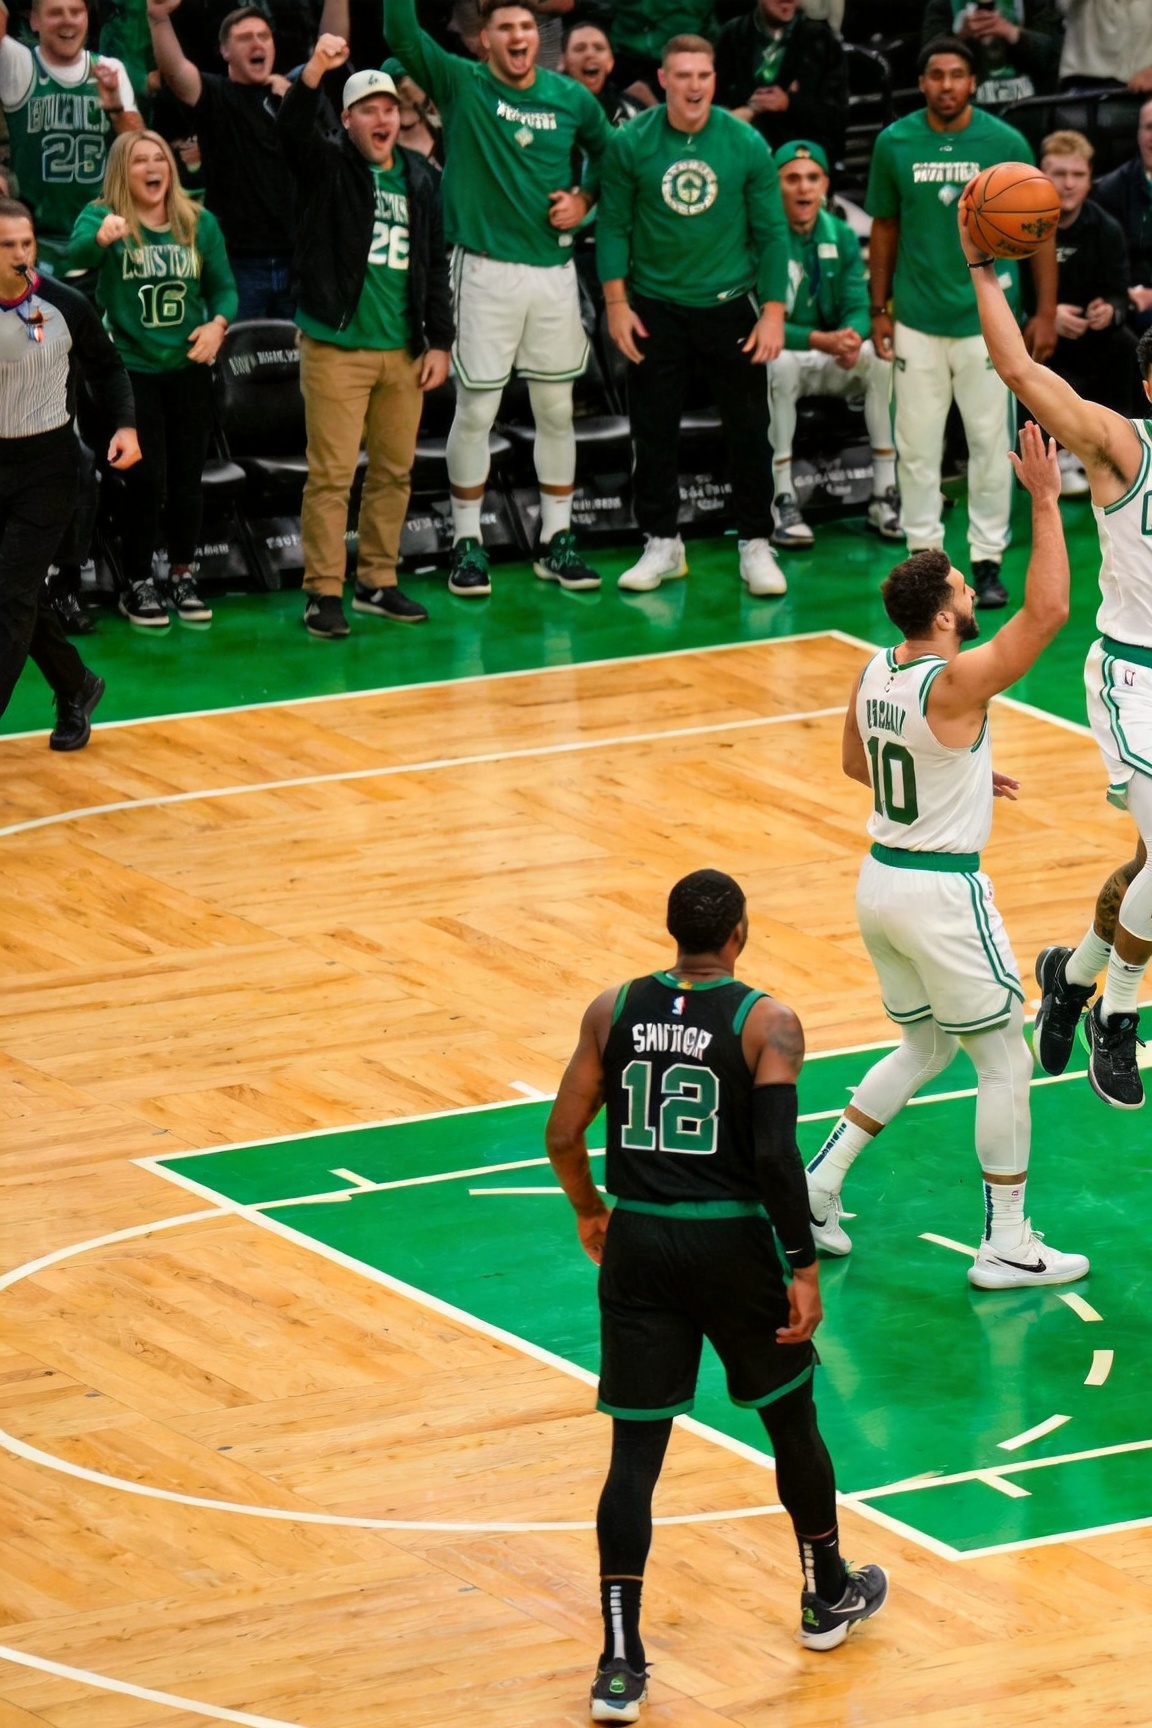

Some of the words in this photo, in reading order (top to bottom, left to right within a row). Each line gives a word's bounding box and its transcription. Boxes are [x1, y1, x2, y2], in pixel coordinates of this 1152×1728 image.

[138, 281, 187, 328] 16
[867, 735, 919, 825] 10
[621, 1060, 720, 1155] 12
